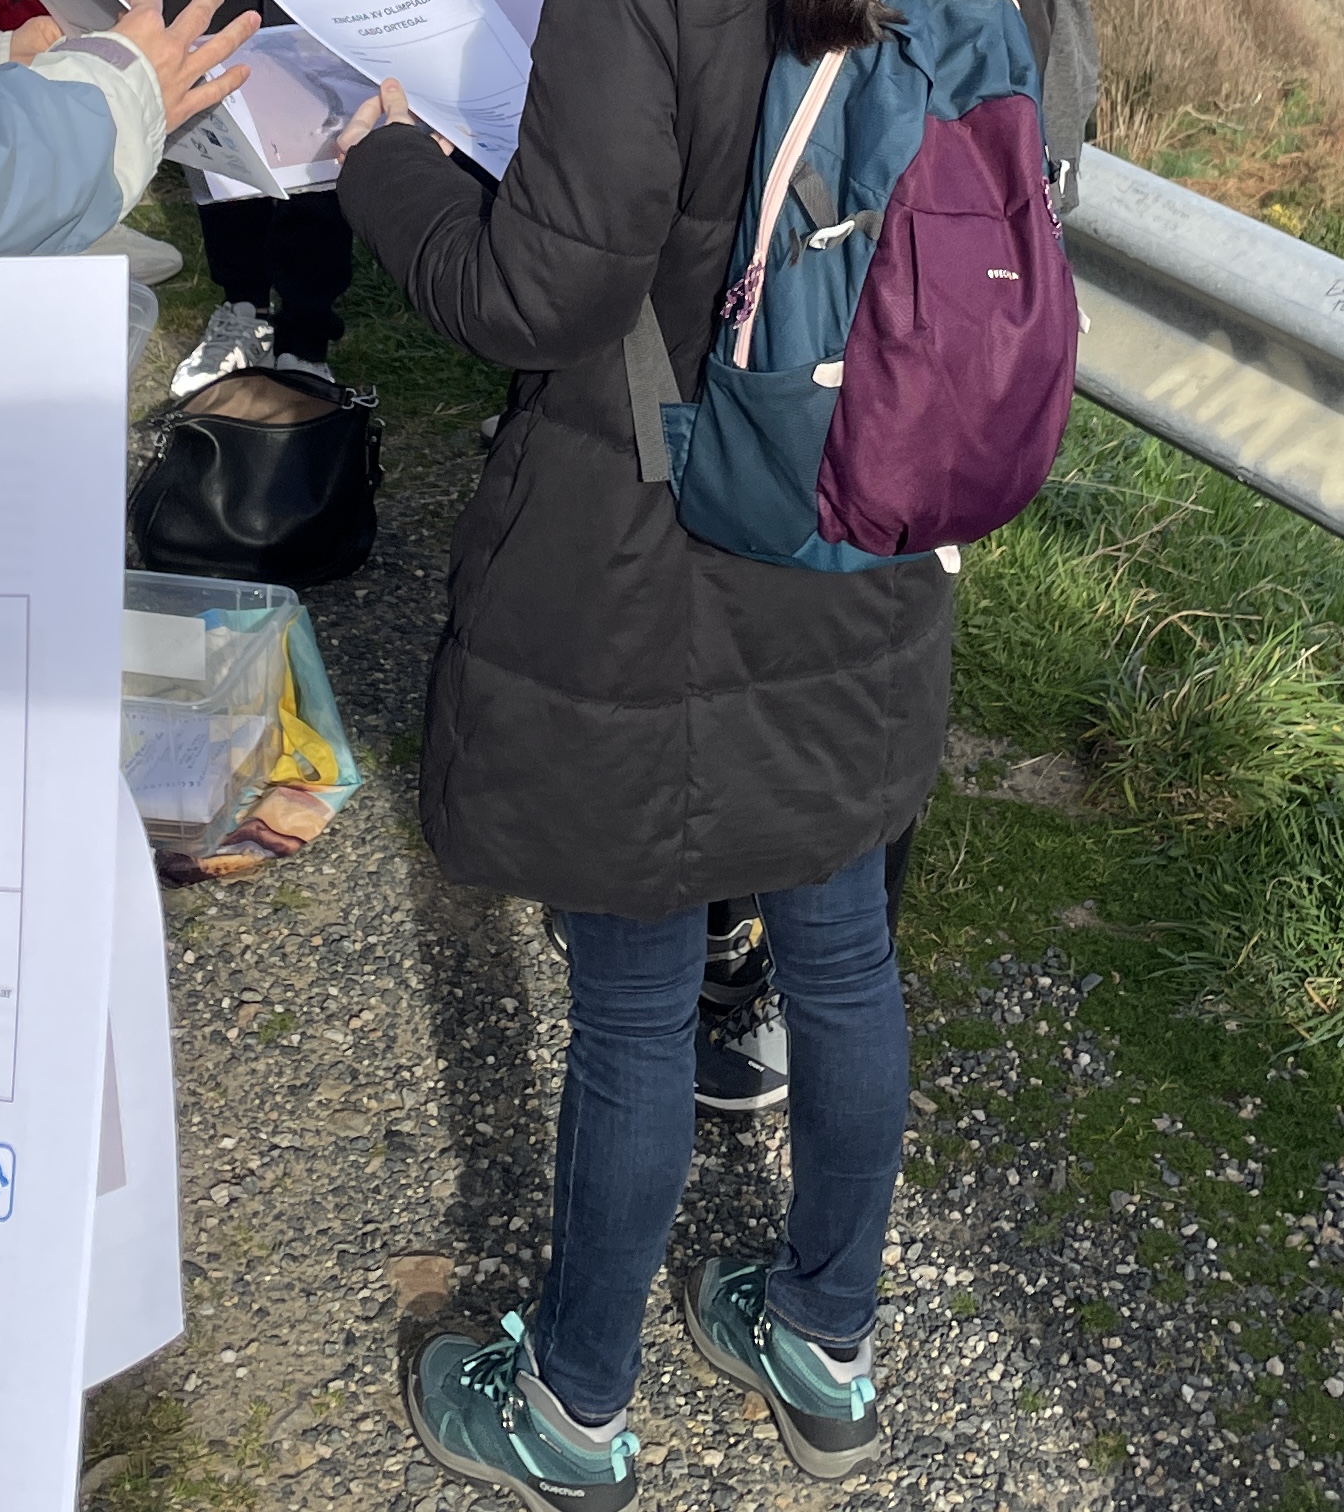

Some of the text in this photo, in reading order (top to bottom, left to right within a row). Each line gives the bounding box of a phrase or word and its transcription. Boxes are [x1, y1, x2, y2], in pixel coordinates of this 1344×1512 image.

[332, 13, 370, 24] XINCANA
[369, 10, 383, 20] XV
[358, 15, 428, 36] CABO ORTEGAL
